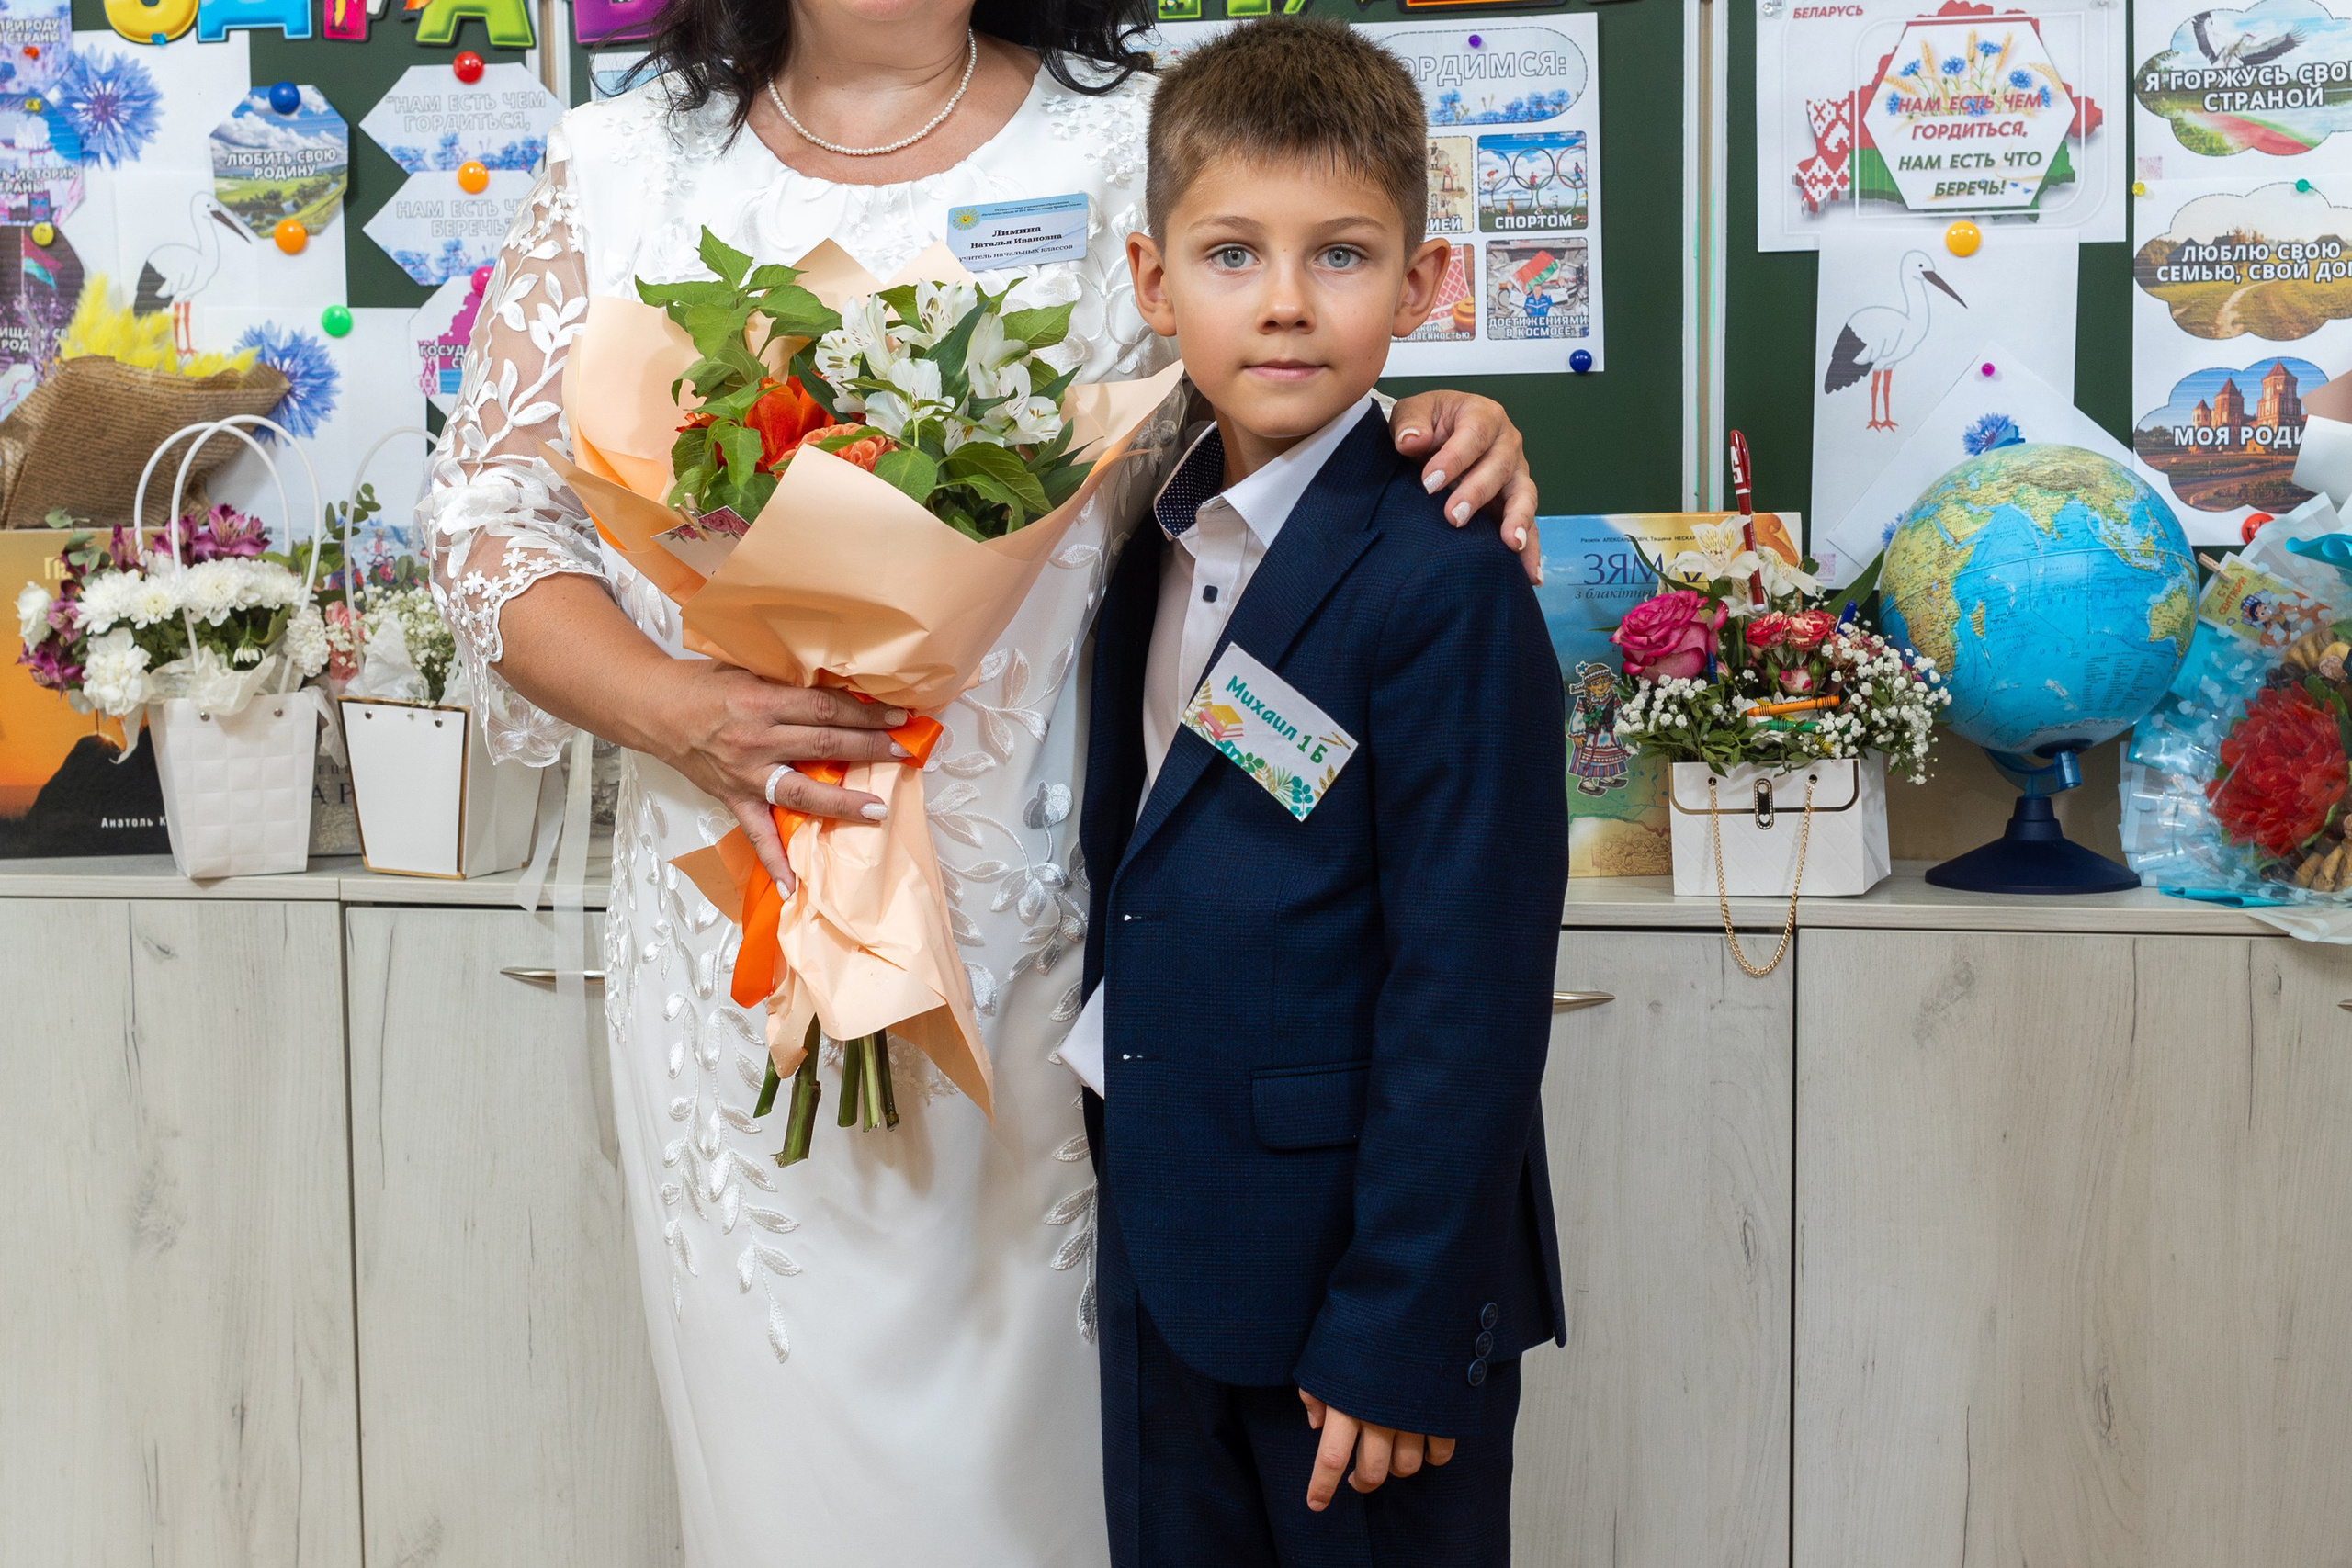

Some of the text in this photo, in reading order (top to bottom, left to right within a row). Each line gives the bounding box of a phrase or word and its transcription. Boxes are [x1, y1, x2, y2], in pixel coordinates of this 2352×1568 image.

[1792, 5, 1864, 19] БЕЛАРУСЬ
[7, 31, 60, 44] СТРАНЫ
[2145, 73, 2160, 91] Я
[2169, 65, 2290, 90] ГОРЖУСЬ
[448, 94, 497, 111] ЕСТЬ
[503, 91, 547, 108] ЧЕМ
[1897, 94, 2042, 113] НАМ ЕСТЬ ЧЕМ
[2205, 82, 2324, 111] СТРАНОЙ
[404, 112, 531, 135] ГОРДИТЬСЯ,
[1911, 121, 2029, 141] ГОРДИТЬСЯ,
[226, 150, 337, 166] ЛЮБИТЬ СВОЮ
[1897, 152, 2043, 171] НАМ ЕСТЬ ЧТО
[15, 167, 79, 181] ИСТОРИЮ
[254, 166, 316, 181] РОДИНУ
[1934, 180, 2007, 197] БЕРЕЧЬ!
[396, 201, 444, 219] НАМ
[450, 200, 499, 218] ЕСТЬ
[1426, 214, 1462, 231] ИЕЙ
[1494, 214, 1572, 230] СПОРТОМ
[992, 226, 1042, 237] Лимина
[970, 233, 1063, 249] Наталья Ивановна
[993, 249, 1040, 258] начальных
[1041, 244, 1073, 254] классов
[2181, 242, 2341, 263] ЛЮБЛЮ СВОЮ
[2156, 265, 2242, 284] СЕМЬЮ,
[2249, 257, 2308, 280] СВОЙ
[1489, 316, 1589, 328] ДОСТИЖЕНИЯМИ
[1506, 326, 1571, 337] В КОСМОСЕ
[2174, 426, 2230, 446] МОЯ
[1226, 675, 1329, 764] Михаил 1 Б
[101, 817, 153, 829] Анатоль
